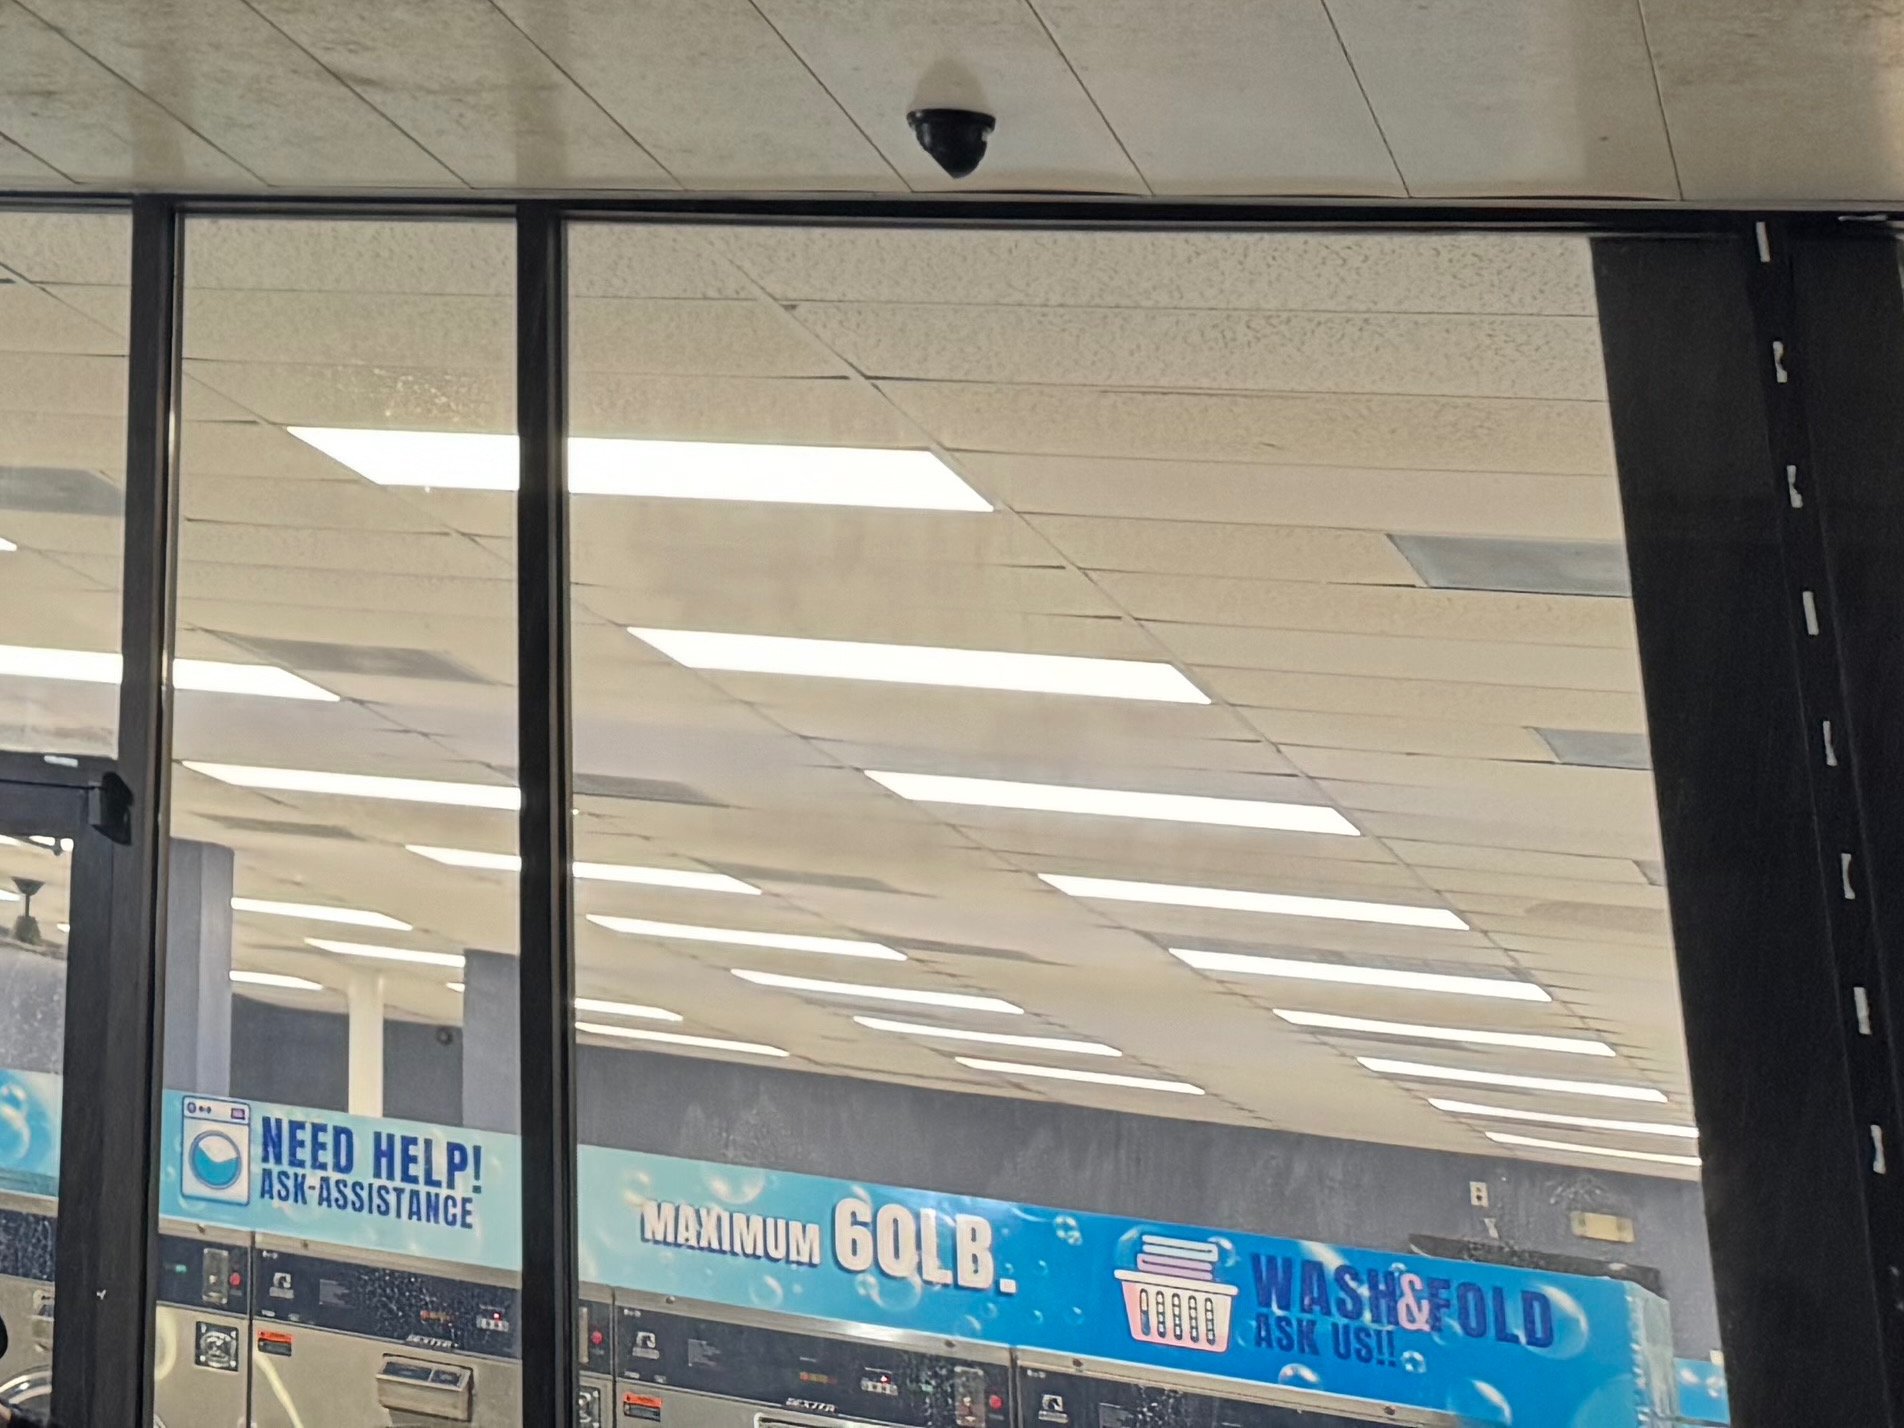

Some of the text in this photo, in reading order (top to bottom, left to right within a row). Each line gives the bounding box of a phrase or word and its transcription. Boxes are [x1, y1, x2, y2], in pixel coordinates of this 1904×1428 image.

[261, 1115, 483, 1195] NEED HELP!
[259, 1167, 475, 1230] ASK-ASSISTANCE
[641, 1196, 1017, 1295] MAXIMUM 60LB.
[1253, 1312, 1398, 1369] ASK US!!
